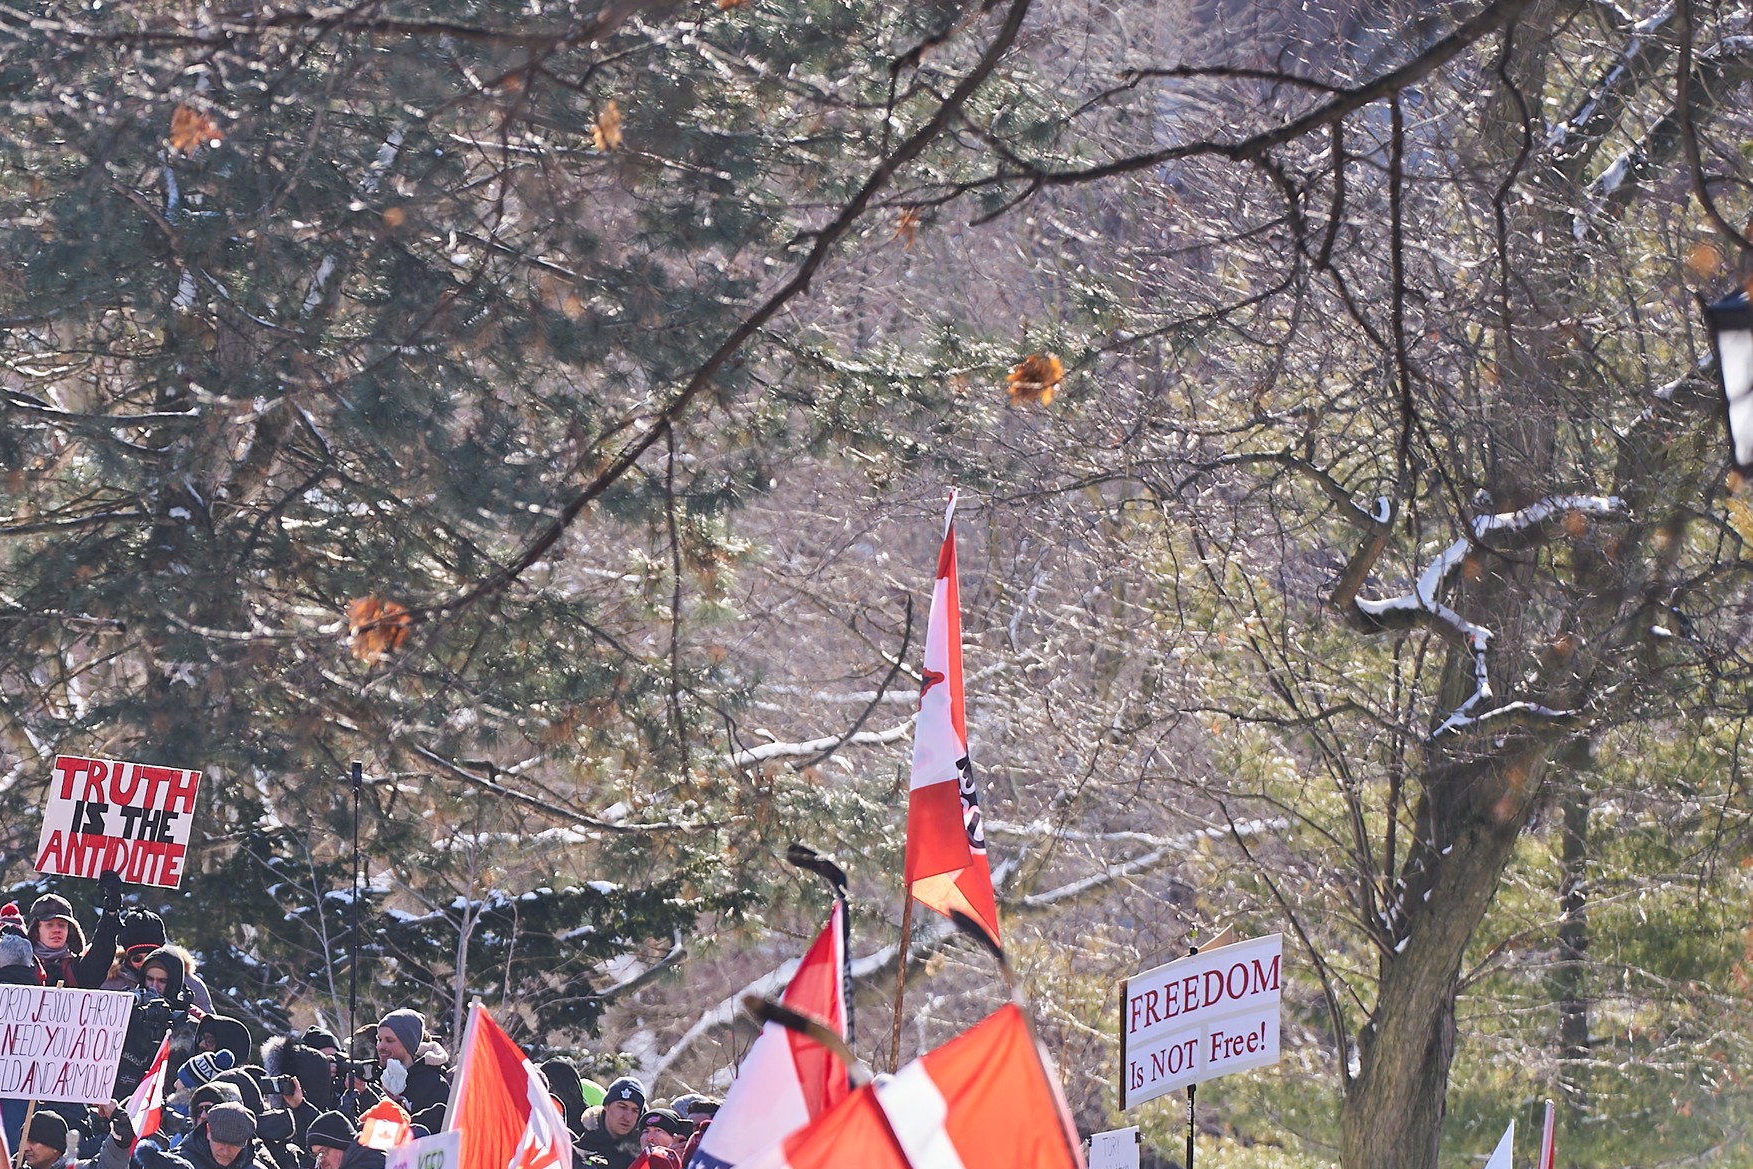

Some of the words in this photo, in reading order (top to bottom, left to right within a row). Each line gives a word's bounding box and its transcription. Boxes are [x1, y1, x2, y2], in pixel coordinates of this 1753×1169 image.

[55, 756, 201, 814] TRUTH
[70, 800, 109, 835] IS
[119, 805, 179, 844] THE
[34, 829, 186, 887] ANTIDOTE
[32, 990, 74, 1023] JESUS
[79, 993, 134, 1028] CHRIST
[1129, 954, 1281, 1034] FREEDOM
[1, 1023, 43, 1057] NEED
[42, 1025, 76, 1058] YOU
[93, 1028, 123, 1062] OUR
[1130, 1061, 1144, 1091] Is
[1150, 1039, 1198, 1082] NOT
[1209, 1021, 1266, 1063] Free!
[20, 1060, 57, 1095] AND
[51, 1061, 114, 1099] ARMOUR
